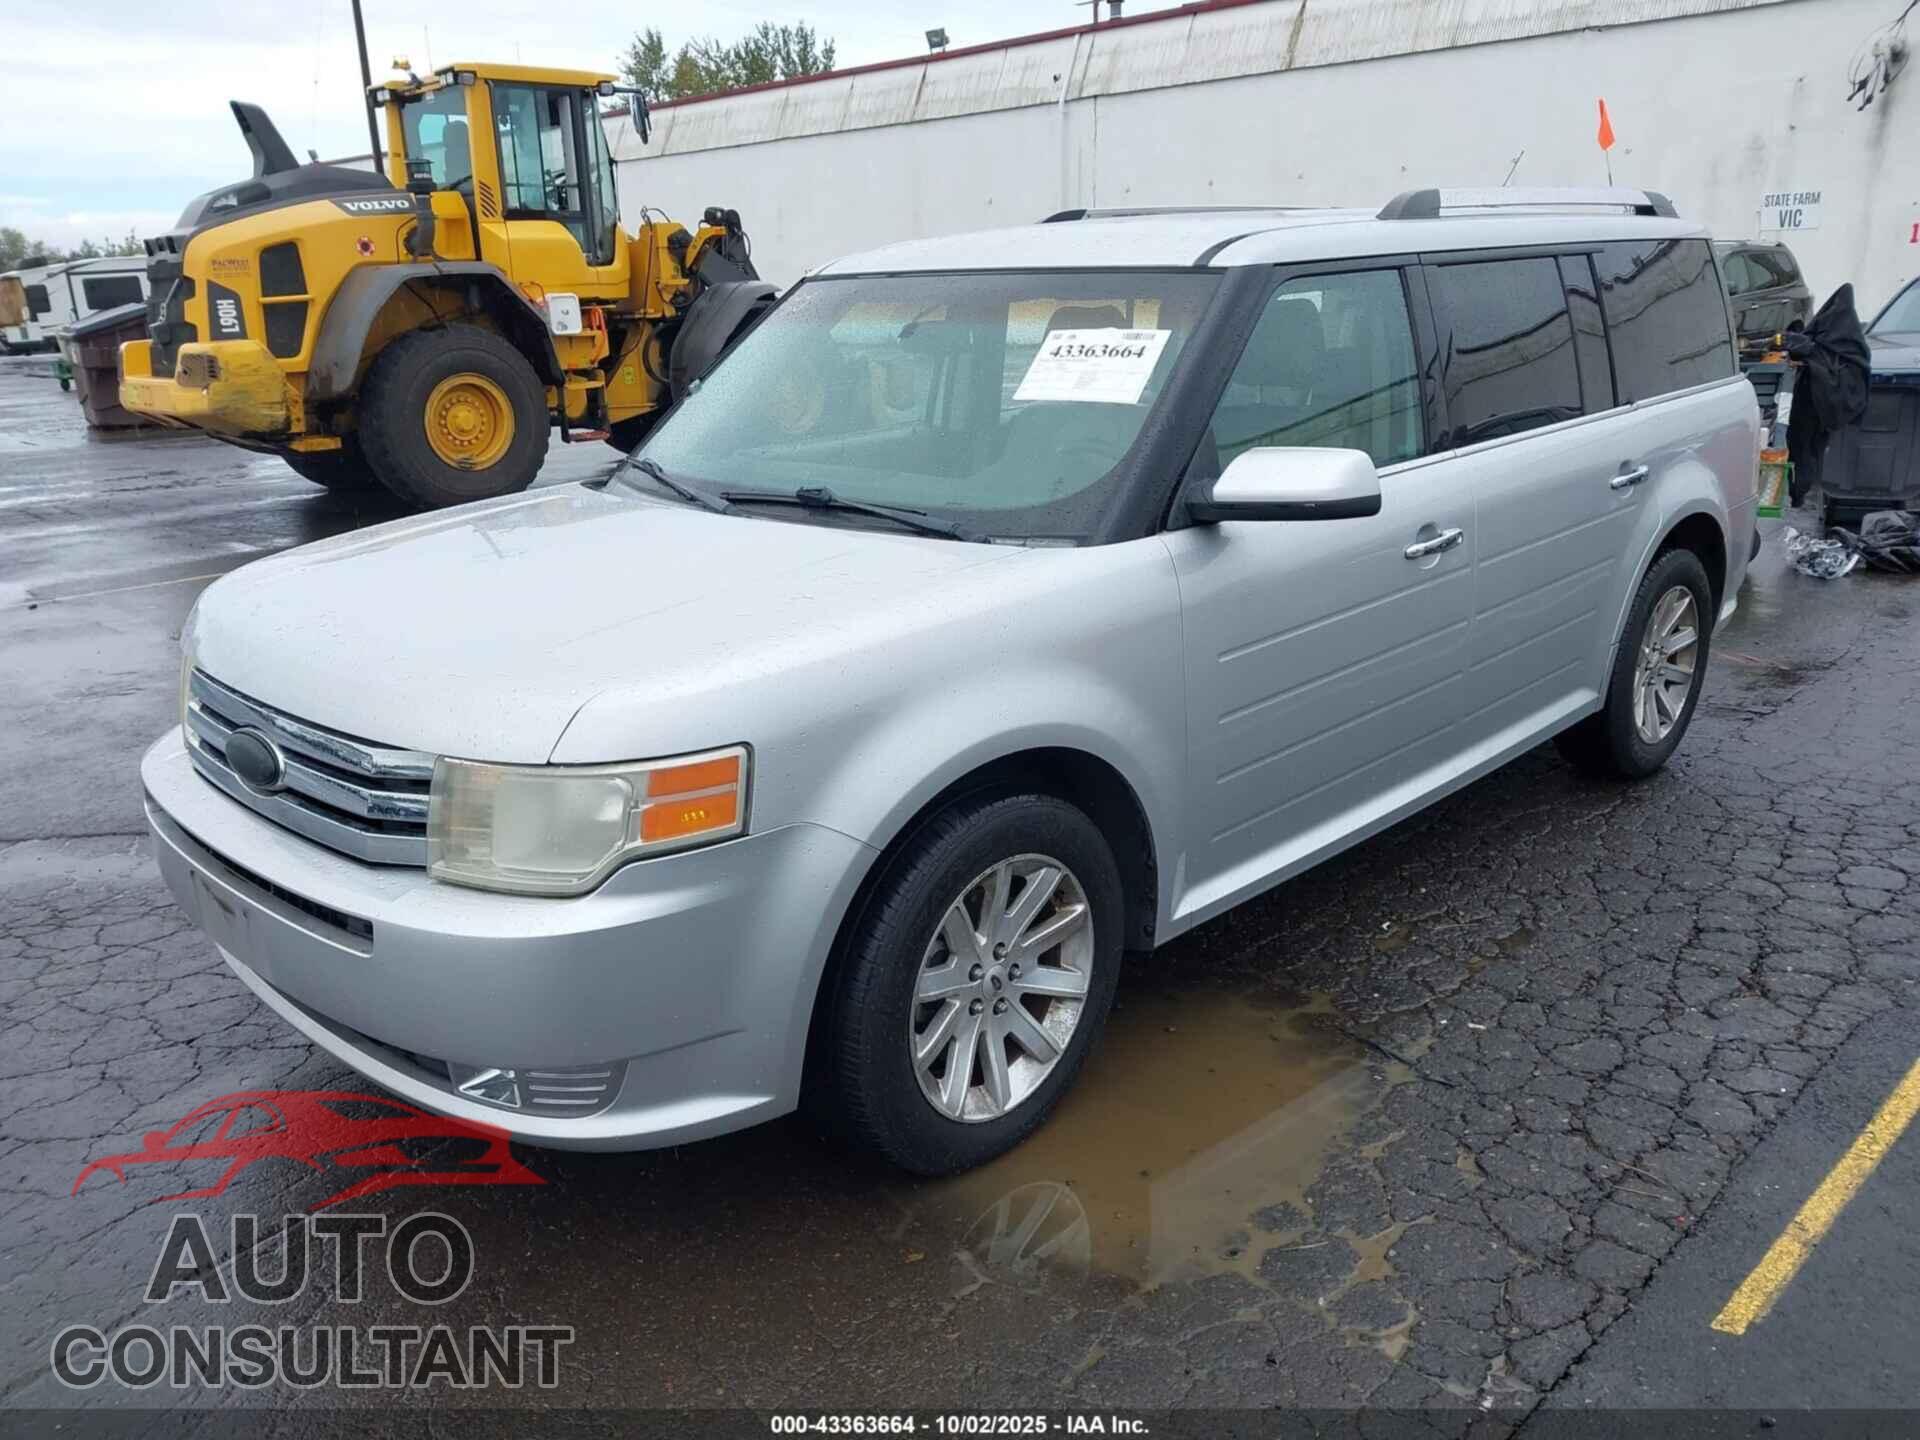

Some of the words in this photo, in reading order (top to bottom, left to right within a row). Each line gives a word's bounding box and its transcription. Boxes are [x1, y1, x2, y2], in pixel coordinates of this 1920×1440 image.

[343, 199, 410, 211] VOLVO
[1764, 193, 1791, 208] STATE
[1793, 191, 1821, 205] FARM
[1779, 209, 1803, 228] VIC
[216, 299, 240, 333] L90H
[1049, 344, 1146, 359] 43363664
